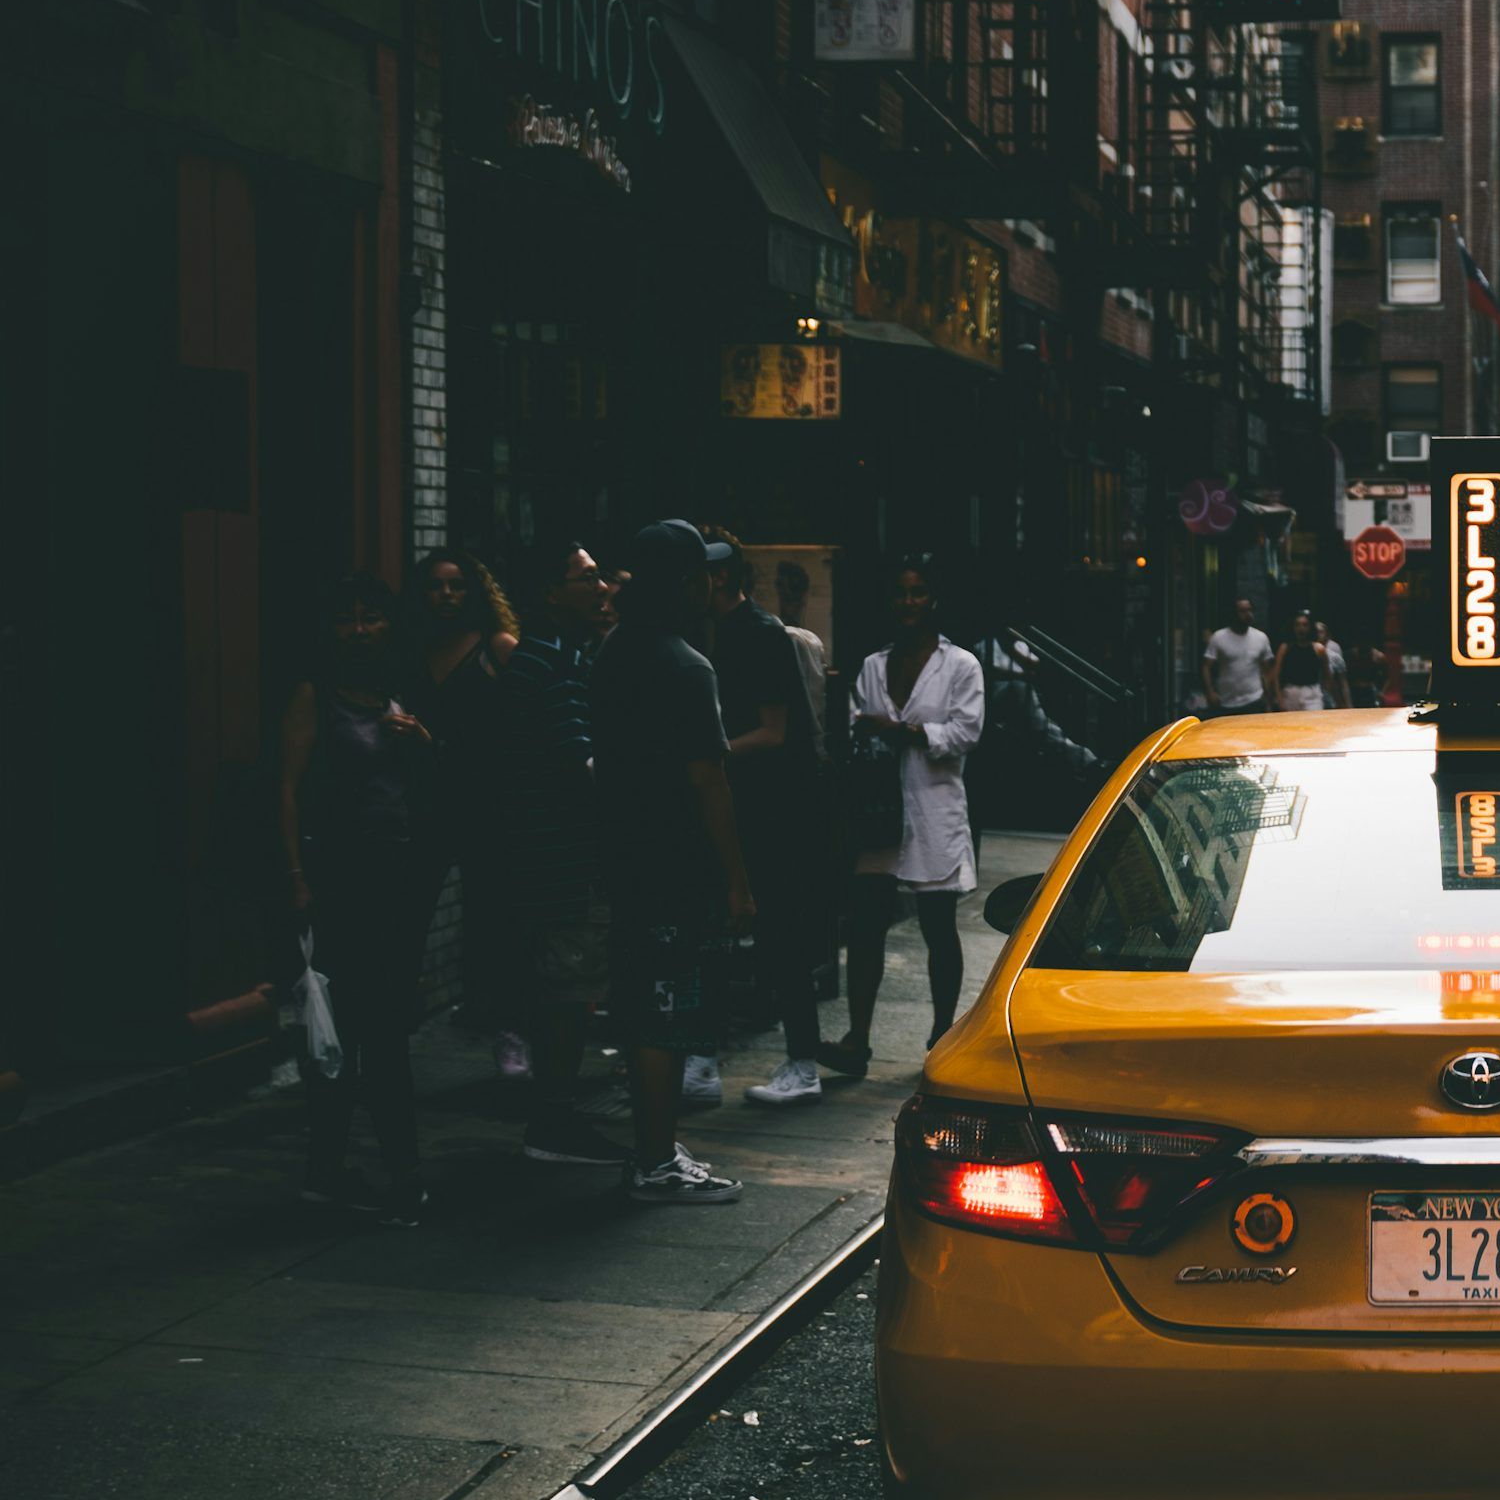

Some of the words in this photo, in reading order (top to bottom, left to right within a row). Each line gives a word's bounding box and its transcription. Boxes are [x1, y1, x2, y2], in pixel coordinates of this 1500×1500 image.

[1356, 542, 1402, 563] STOP
[1465, 478, 1496, 660] 3L28
[1424, 1197, 1475, 1220] NEW
[1174, 1264, 1299, 1285] CAMRY
[1462, 1286, 1499, 1299] TAXI
